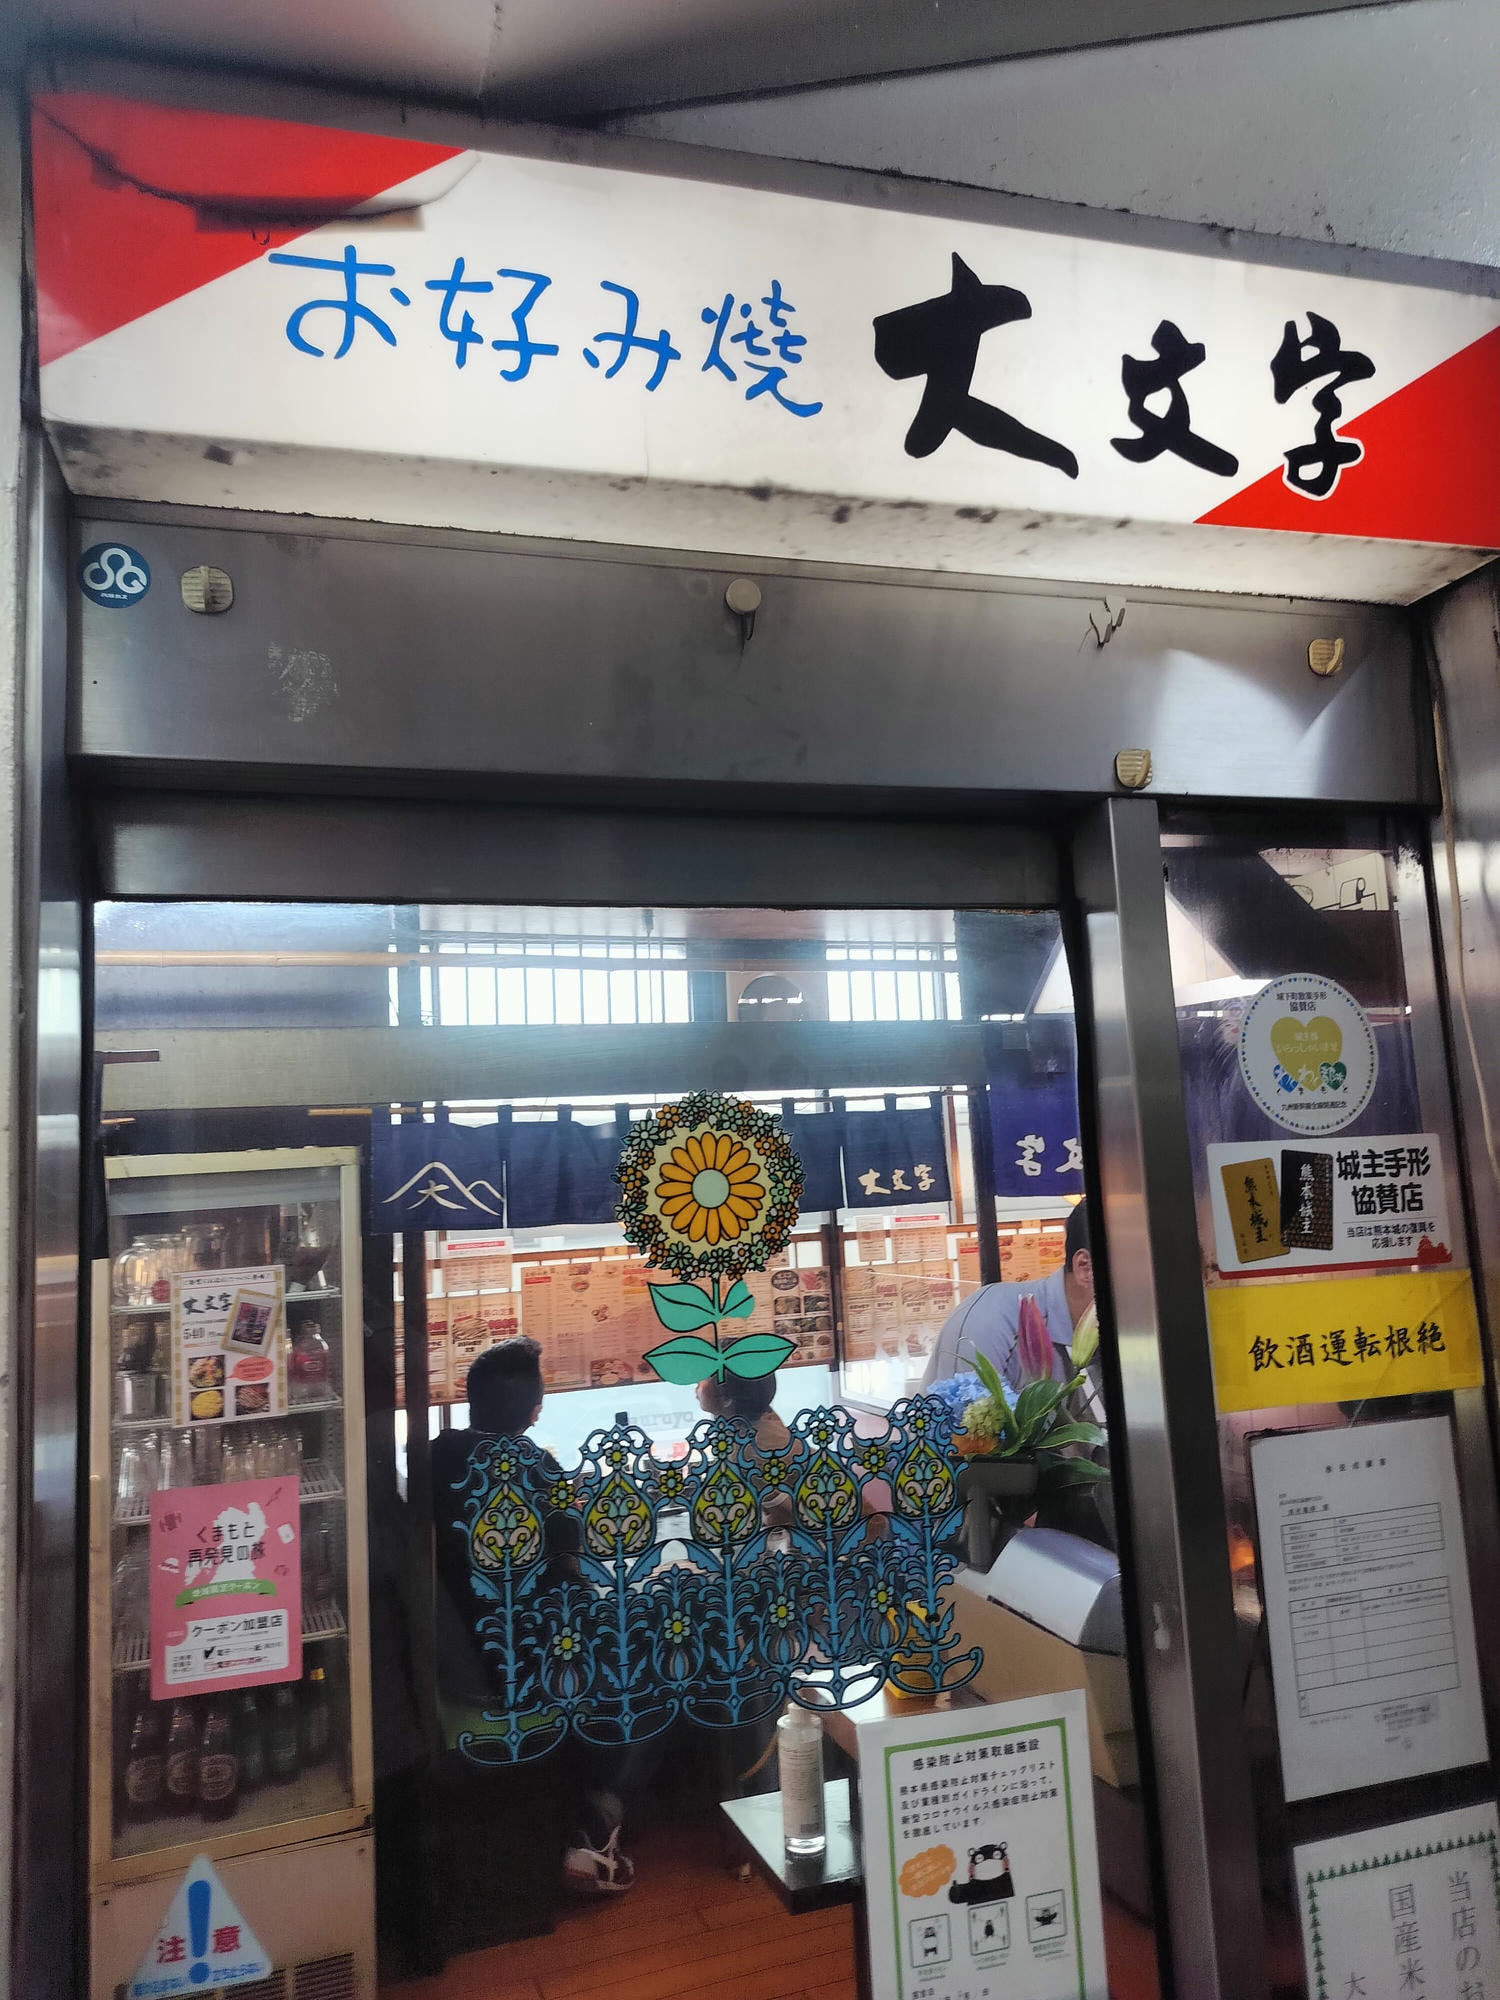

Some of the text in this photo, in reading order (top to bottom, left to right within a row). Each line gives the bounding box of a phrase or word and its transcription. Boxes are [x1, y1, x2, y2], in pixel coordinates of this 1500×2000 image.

[872, 251, 1376, 497] 大文字
[857, 1164, 935, 1197] 大文字
[1336, 1146, 1431, 1181] 城主手形
[1243, 1175, 1269, 1244] 熊本城主
[1299, 1164, 1316, 1234] 熊本城主
[1351, 1182, 1424, 1216] 協賛店
[1247, 1320, 1447, 1372] 飲酒運転根絶
[196, 1522, 256, 1543] くまもと
[189, 1541, 266, 1568] 再発見の旅
[191, 1615, 283, 1638] クーポン加盟店
[912, 1738, 1041, 1771] 感染防止対策取組施設
[1389, 1883, 1426, 2000] 国産米
